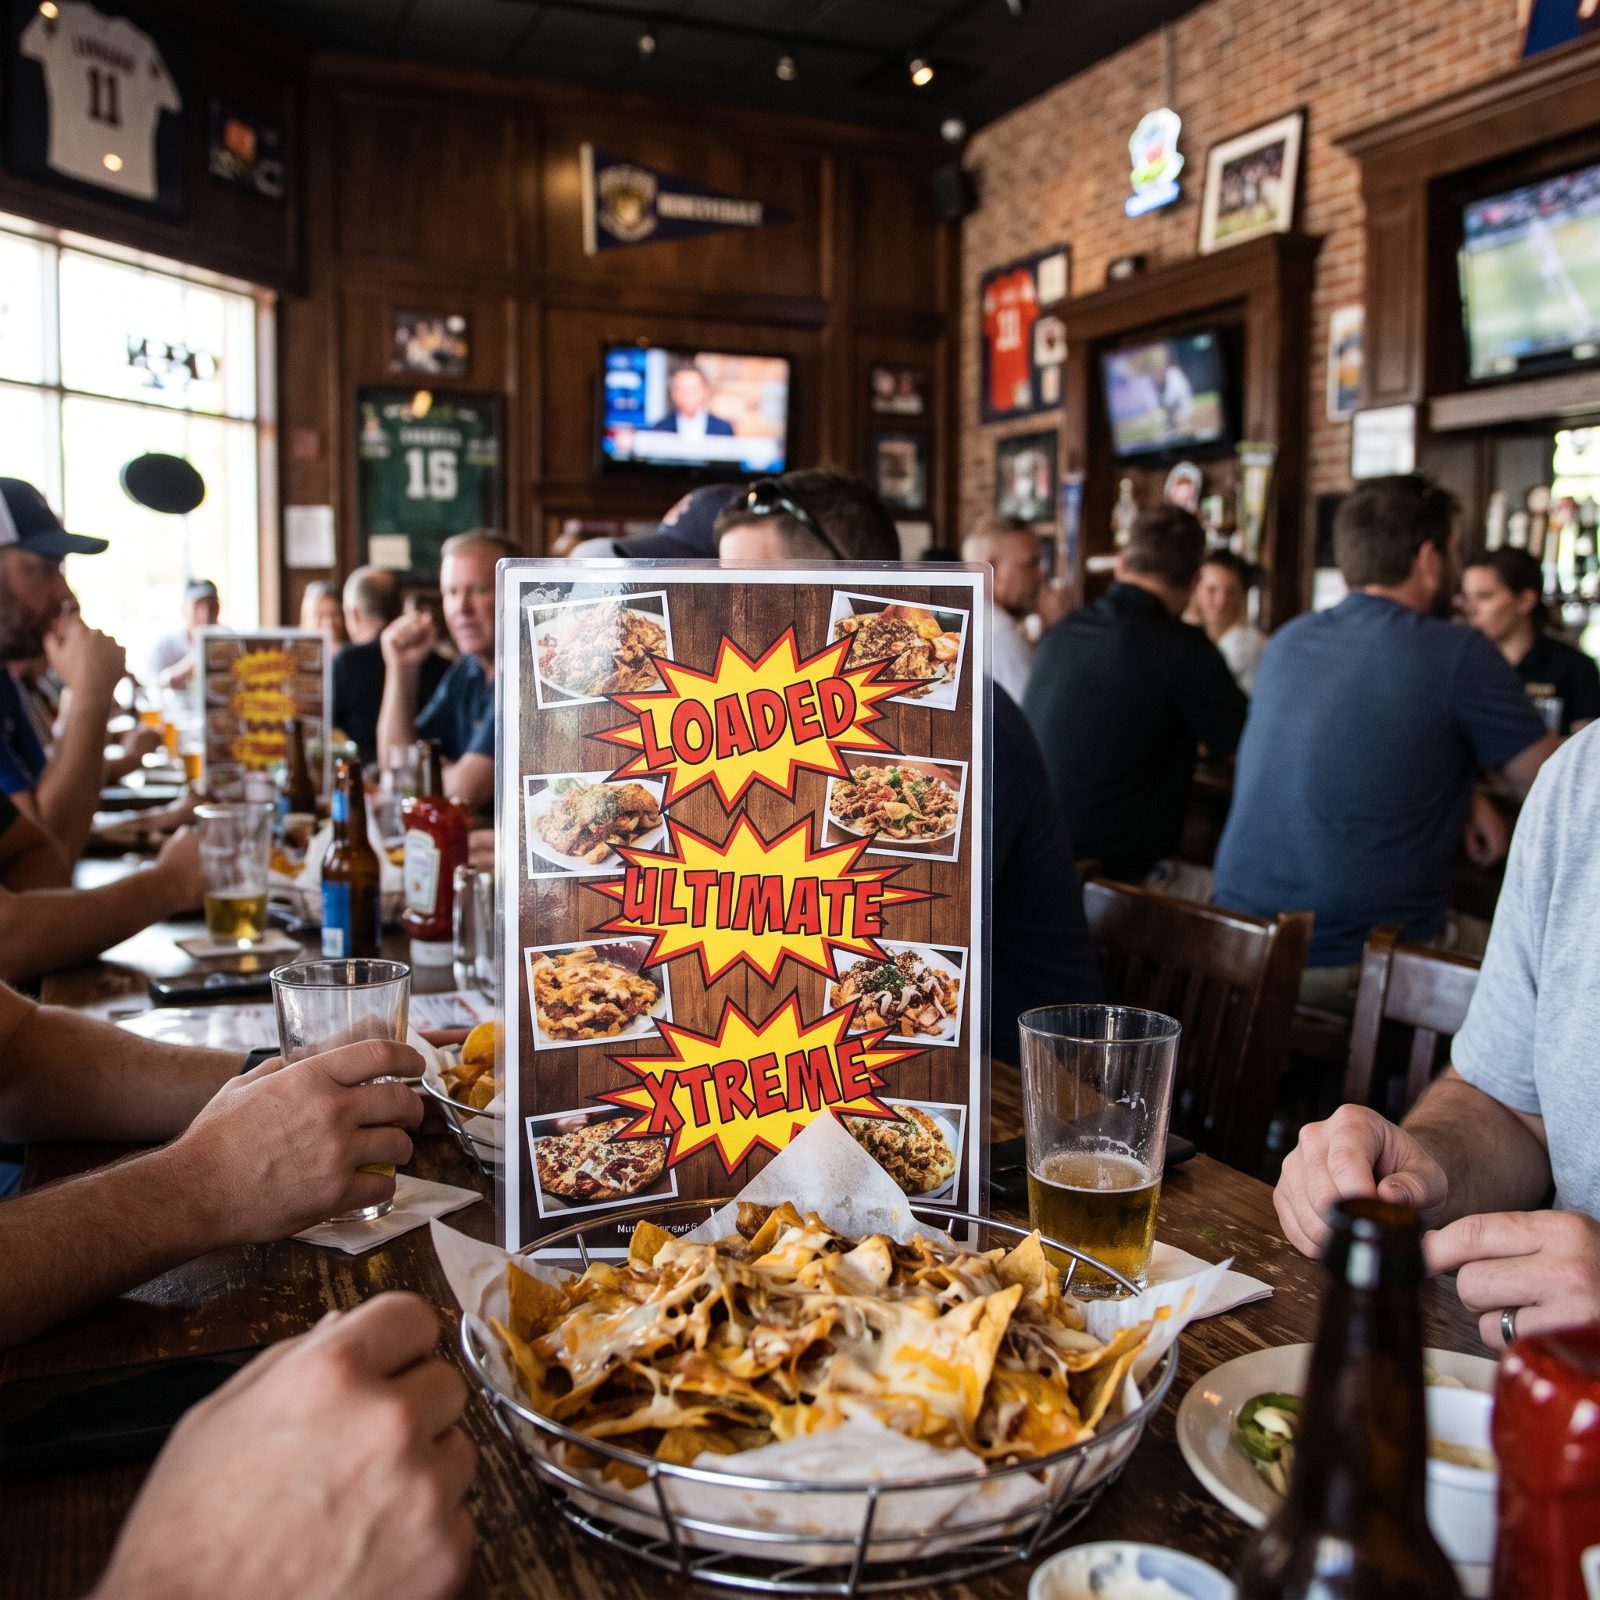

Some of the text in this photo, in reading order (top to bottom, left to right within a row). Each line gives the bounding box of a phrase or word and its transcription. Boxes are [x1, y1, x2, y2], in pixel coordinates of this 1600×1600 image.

[639, 676, 857, 771] LOADED
[623, 866, 885, 938] ULTIMATE
[643, 1038, 874, 1134] XTREME
